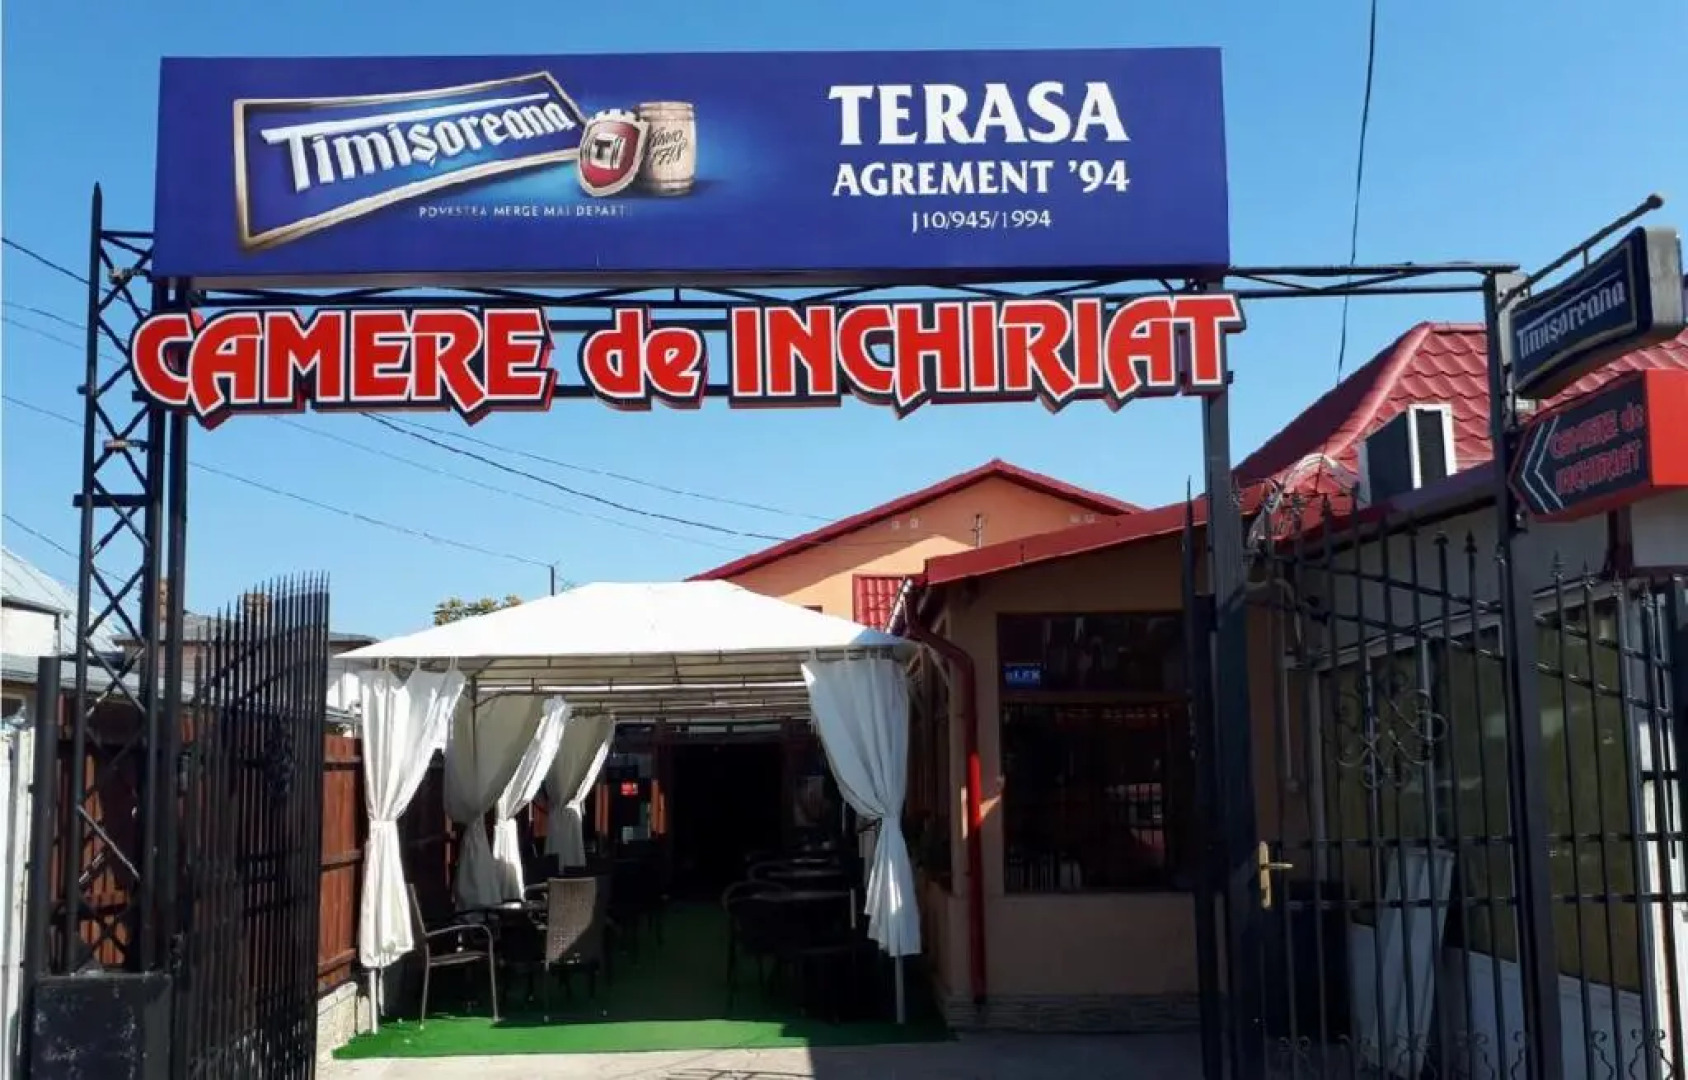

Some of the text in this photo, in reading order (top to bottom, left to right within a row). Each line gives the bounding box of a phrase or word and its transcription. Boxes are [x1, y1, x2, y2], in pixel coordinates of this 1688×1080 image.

[828, 80, 1131, 146] TERASA
[832, 159, 1131, 197] AGREMENT '94
[494, 204, 539, 218] MERGE
[543, 204, 571, 217] MAI
[575, 204, 632, 218] DEPART
[911, 209, 1052, 234] J10/945/1994
[131, 294, 1243, 417] CAMERE de INCHIRIAT
